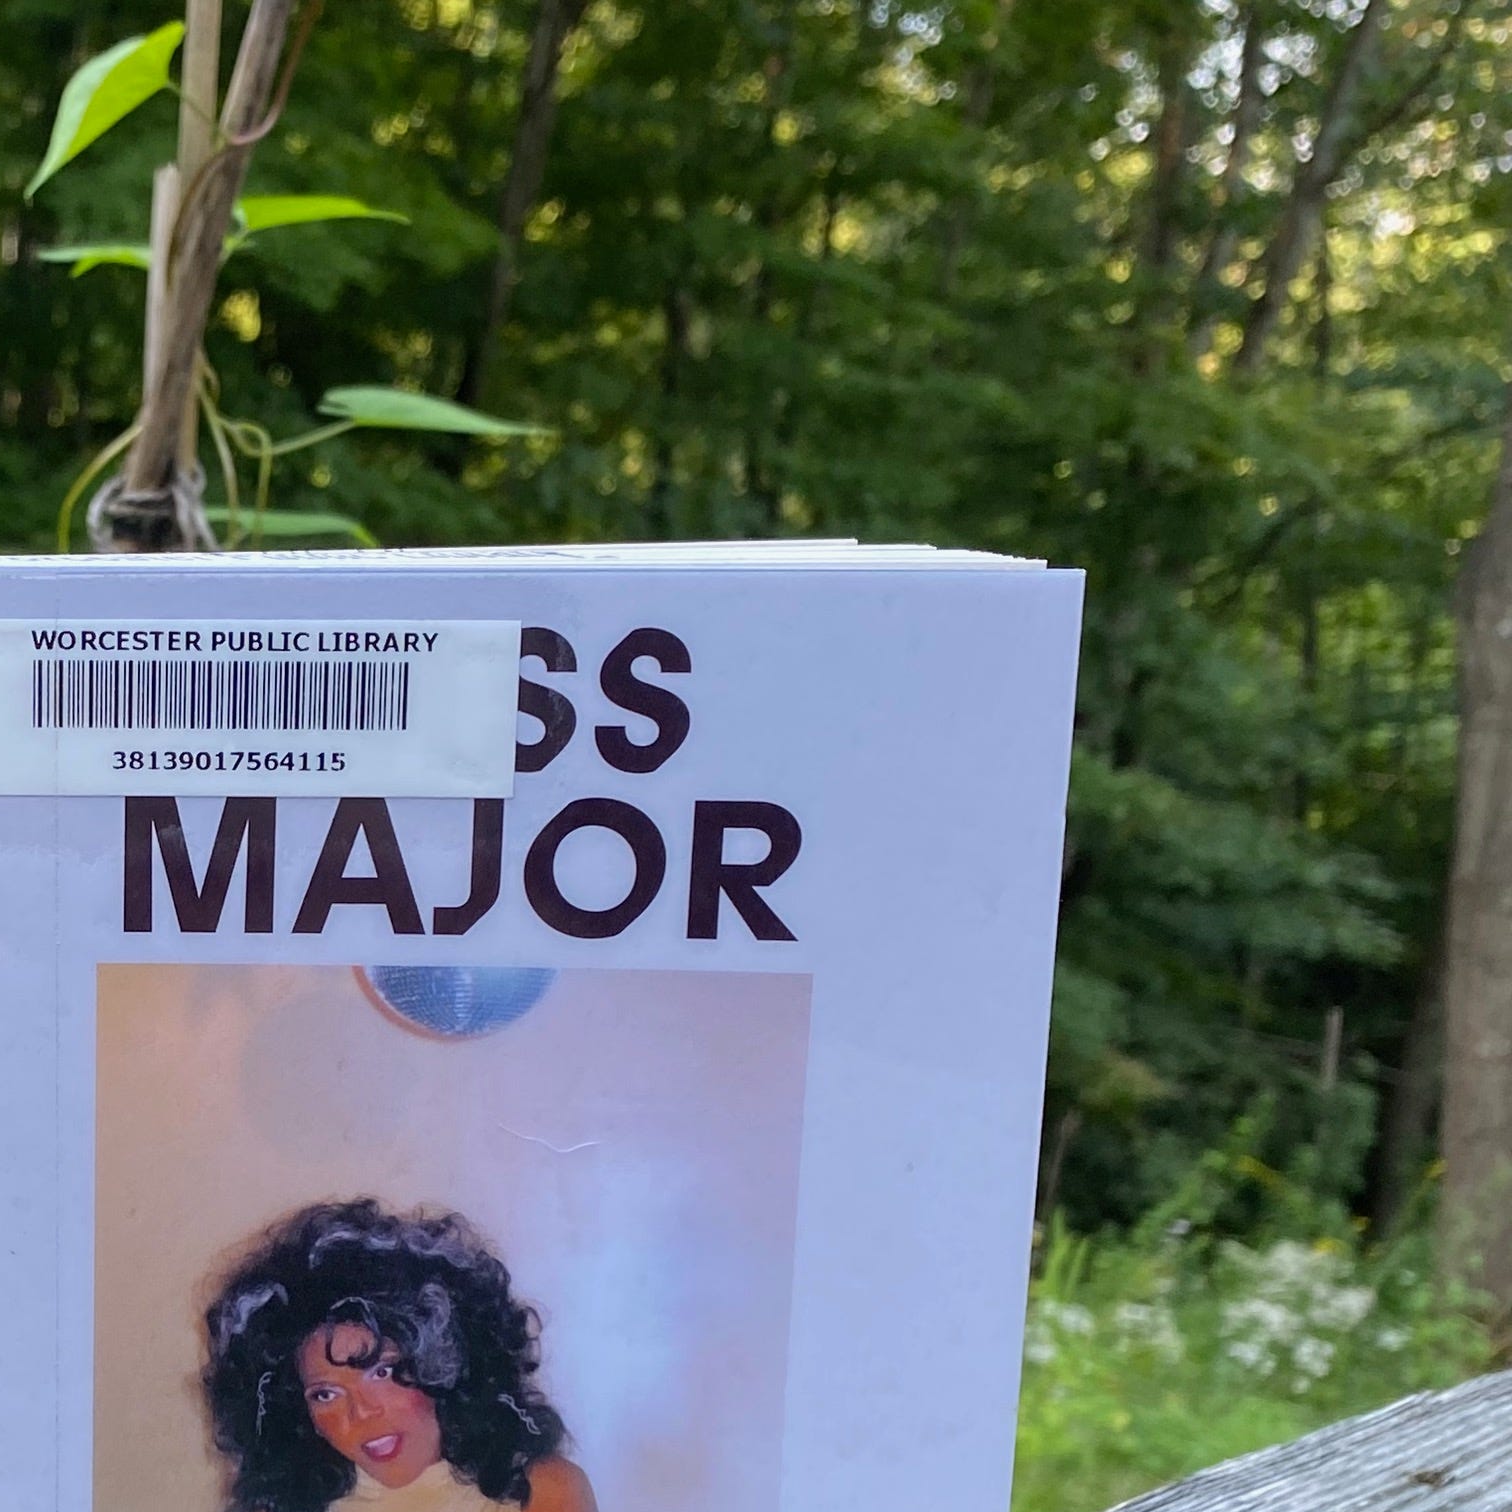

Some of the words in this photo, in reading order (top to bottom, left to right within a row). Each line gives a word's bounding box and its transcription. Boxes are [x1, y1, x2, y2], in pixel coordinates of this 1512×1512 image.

[31, 629, 203, 653] WORCESTER
[211, 631, 310, 653] PUBLIC
[318, 631, 439, 654] LIBRARY
[515, 626, 693, 774] SS
[112, 750, 347, 773] 38139017564115
[123, 797, 803, 943] MAJOR
